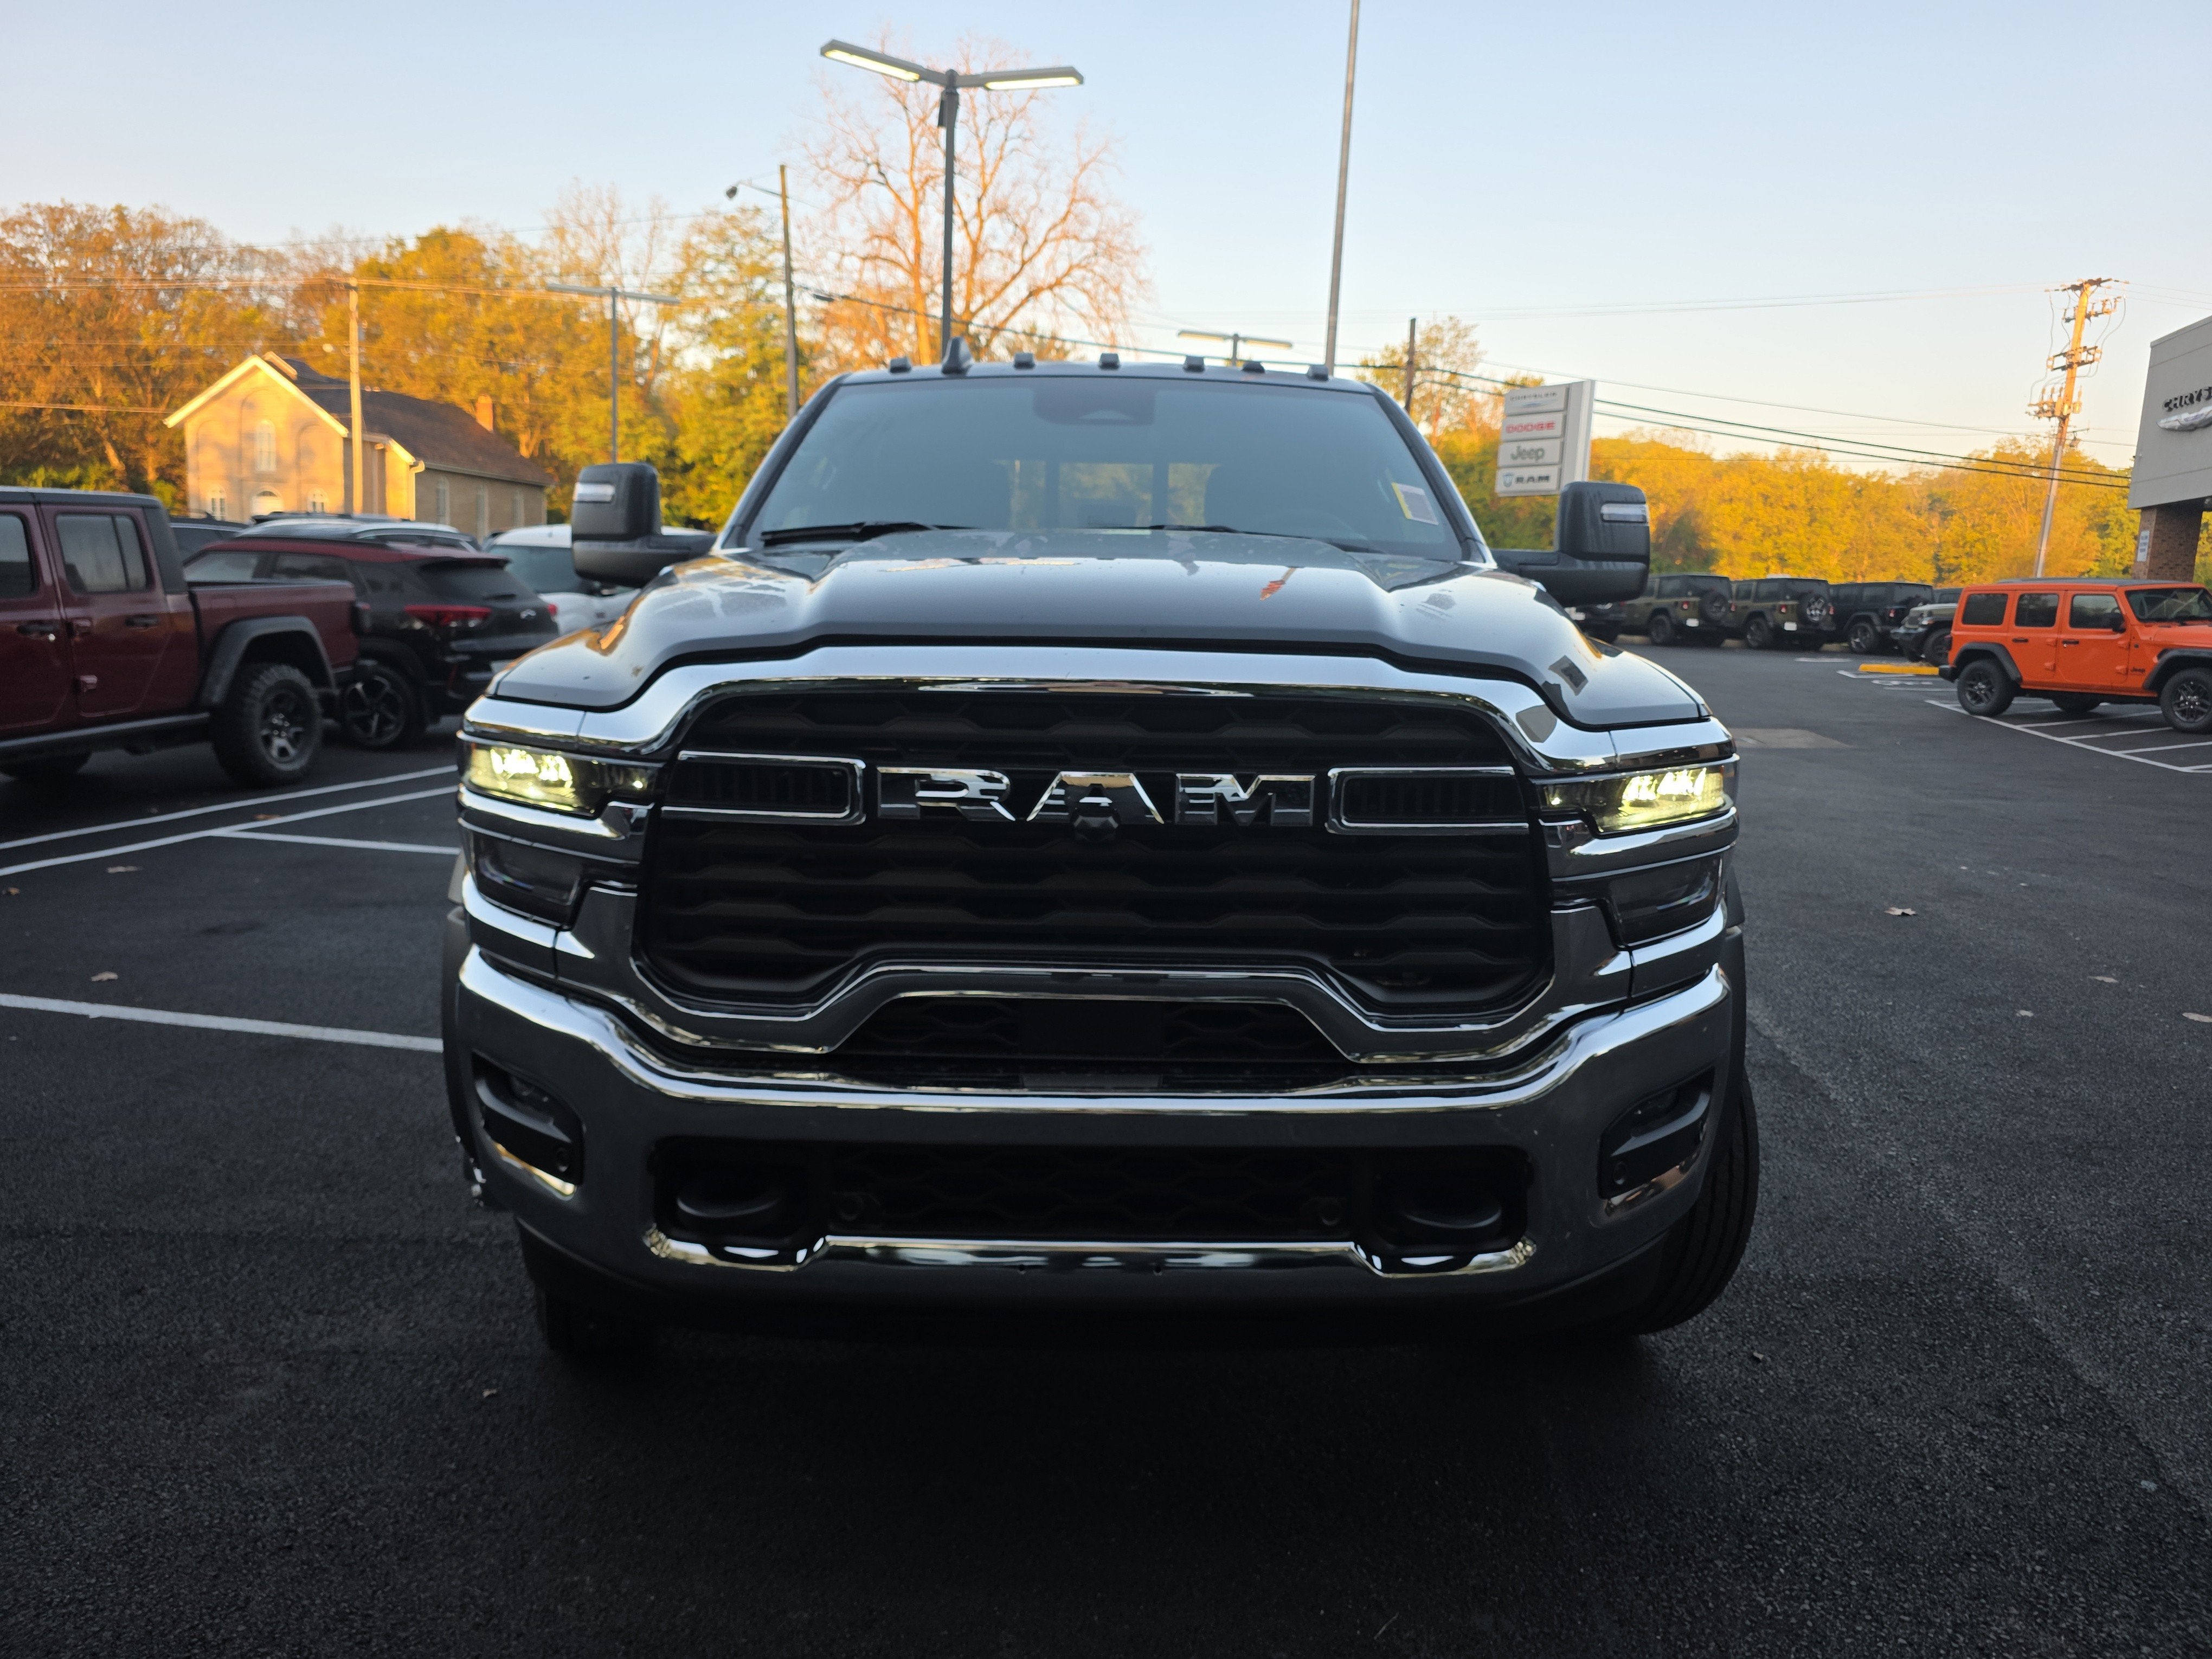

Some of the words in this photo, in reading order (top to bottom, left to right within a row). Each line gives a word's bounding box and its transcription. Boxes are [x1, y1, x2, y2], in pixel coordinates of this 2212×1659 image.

[1506, 421, 1555, 433] DODGE
[1510, 446, 1545, 461] Jeep
[1516, 475, 1549, 484] RAM
[877, 766, 1316, 826] RAM
